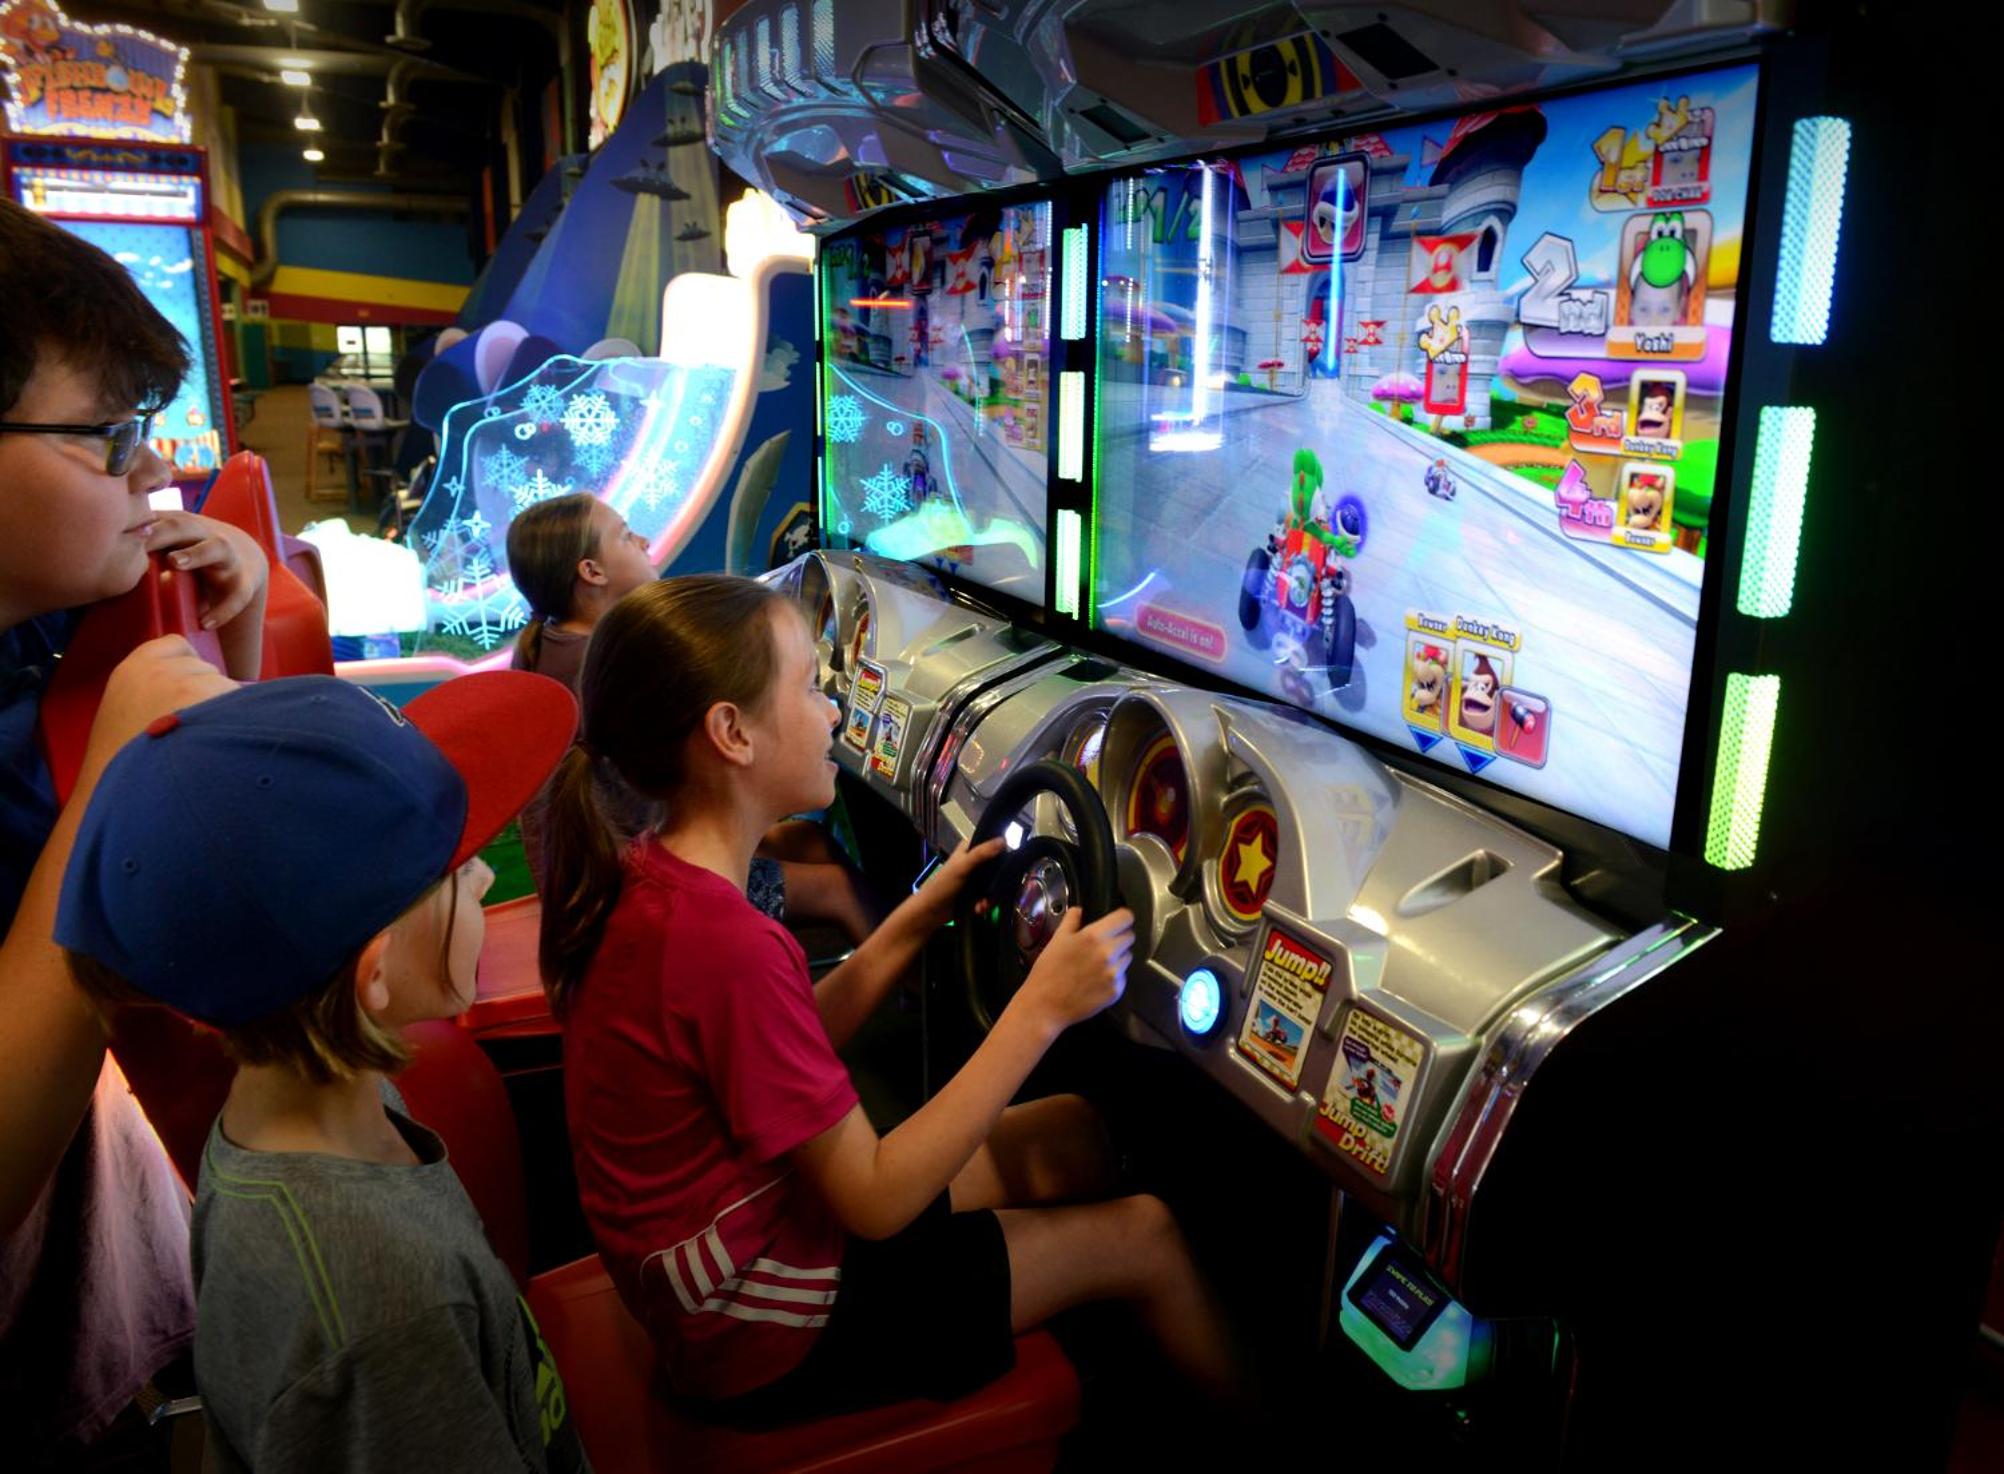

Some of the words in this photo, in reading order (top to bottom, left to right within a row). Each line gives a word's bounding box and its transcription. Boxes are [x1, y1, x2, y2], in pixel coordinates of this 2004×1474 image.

[46, 88, 152, 125] FRENZY
[1633, 332, 1675, 353] Yoshi
[1564, 371, 1624, 438] 3rd
[1555, 459, 1615, 528] 4th
[1455, 615, 1490, 641] Donkey
[1491, 624, 1517, 648] Kong
[1264, 939, 1332, 986] Jump!!
[1319, 1101, 1367, 1138] Jump
[1338, 1133, 1390, 1175] Drift!
